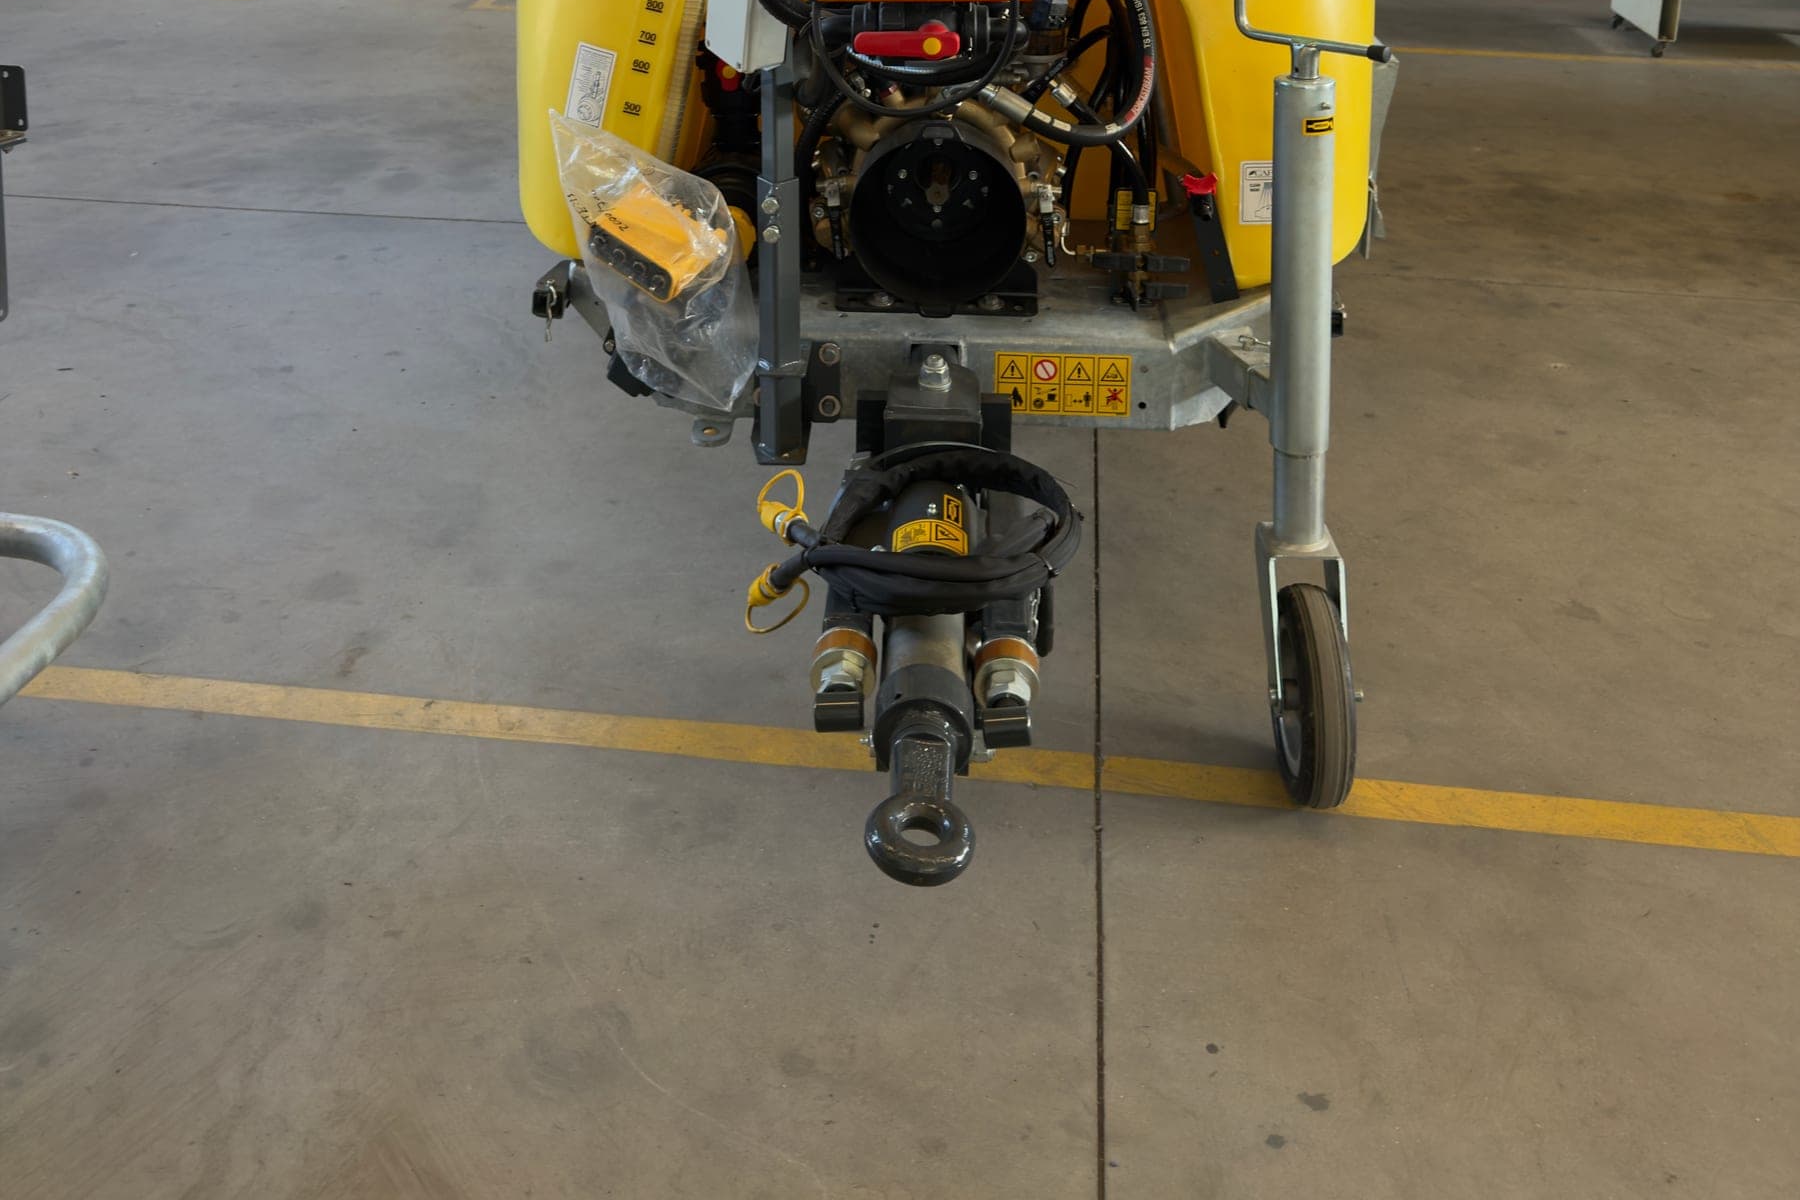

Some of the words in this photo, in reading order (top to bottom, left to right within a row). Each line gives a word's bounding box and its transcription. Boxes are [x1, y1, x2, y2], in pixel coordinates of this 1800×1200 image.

[646, 0, 664, 10] 800
[639, 30, 657, 42] 700
[632, 59, 650, 71] 600
[623, 101, 641, 113] 500
